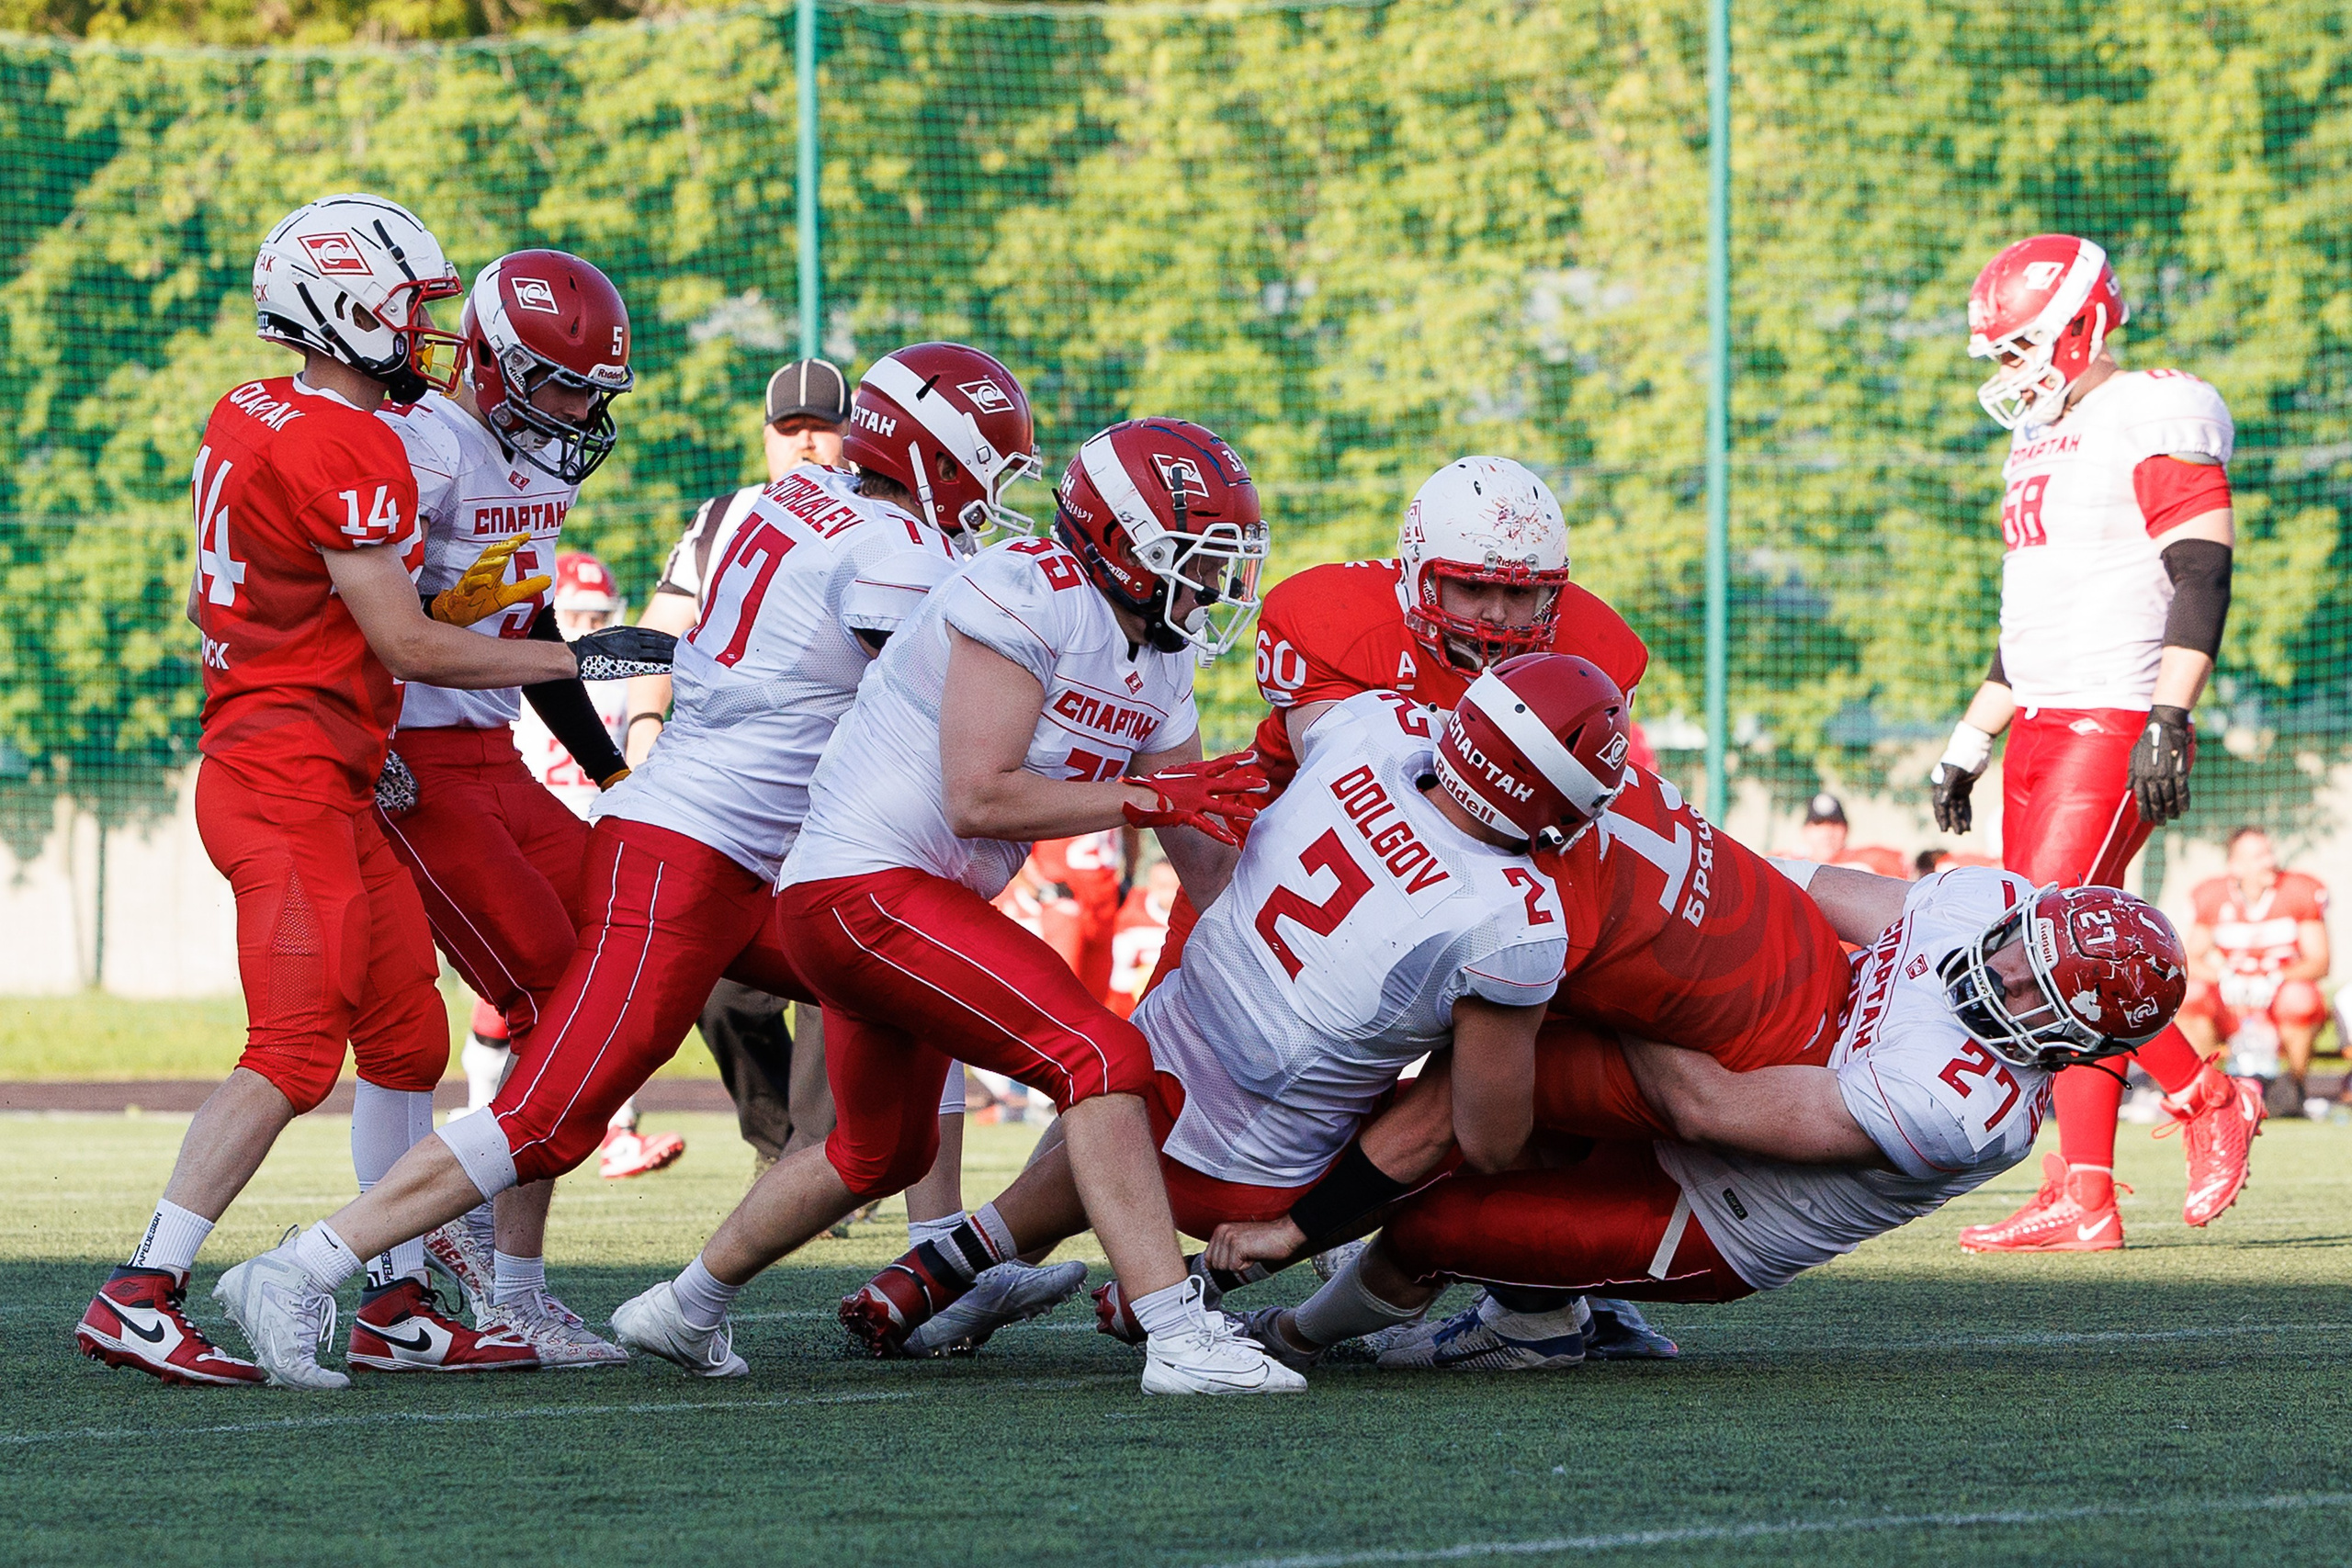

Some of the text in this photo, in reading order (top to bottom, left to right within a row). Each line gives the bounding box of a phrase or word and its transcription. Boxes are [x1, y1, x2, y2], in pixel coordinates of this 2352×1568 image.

[611, 325, 624, 356] 5
[191, 444, 247, 607] 14
[338, 484, 401, 536] 14
[686, 511, 797, 669] 17
[1255, 619, 1307, 691] 60
[1396, 649, 1418, 679] A
[1433, 758, 1497, 825] Riddell
[1447, 710, 1535, 804] СПАРТАК
[1329, 763, 1451, 896] DOLGOV
[1254, 826, 1375, 984] 2
[1500, 867, 1555, 926] 2
[2078, 909, 2117, 946] 27
[1937, 1036, 2022, 1134] 27
